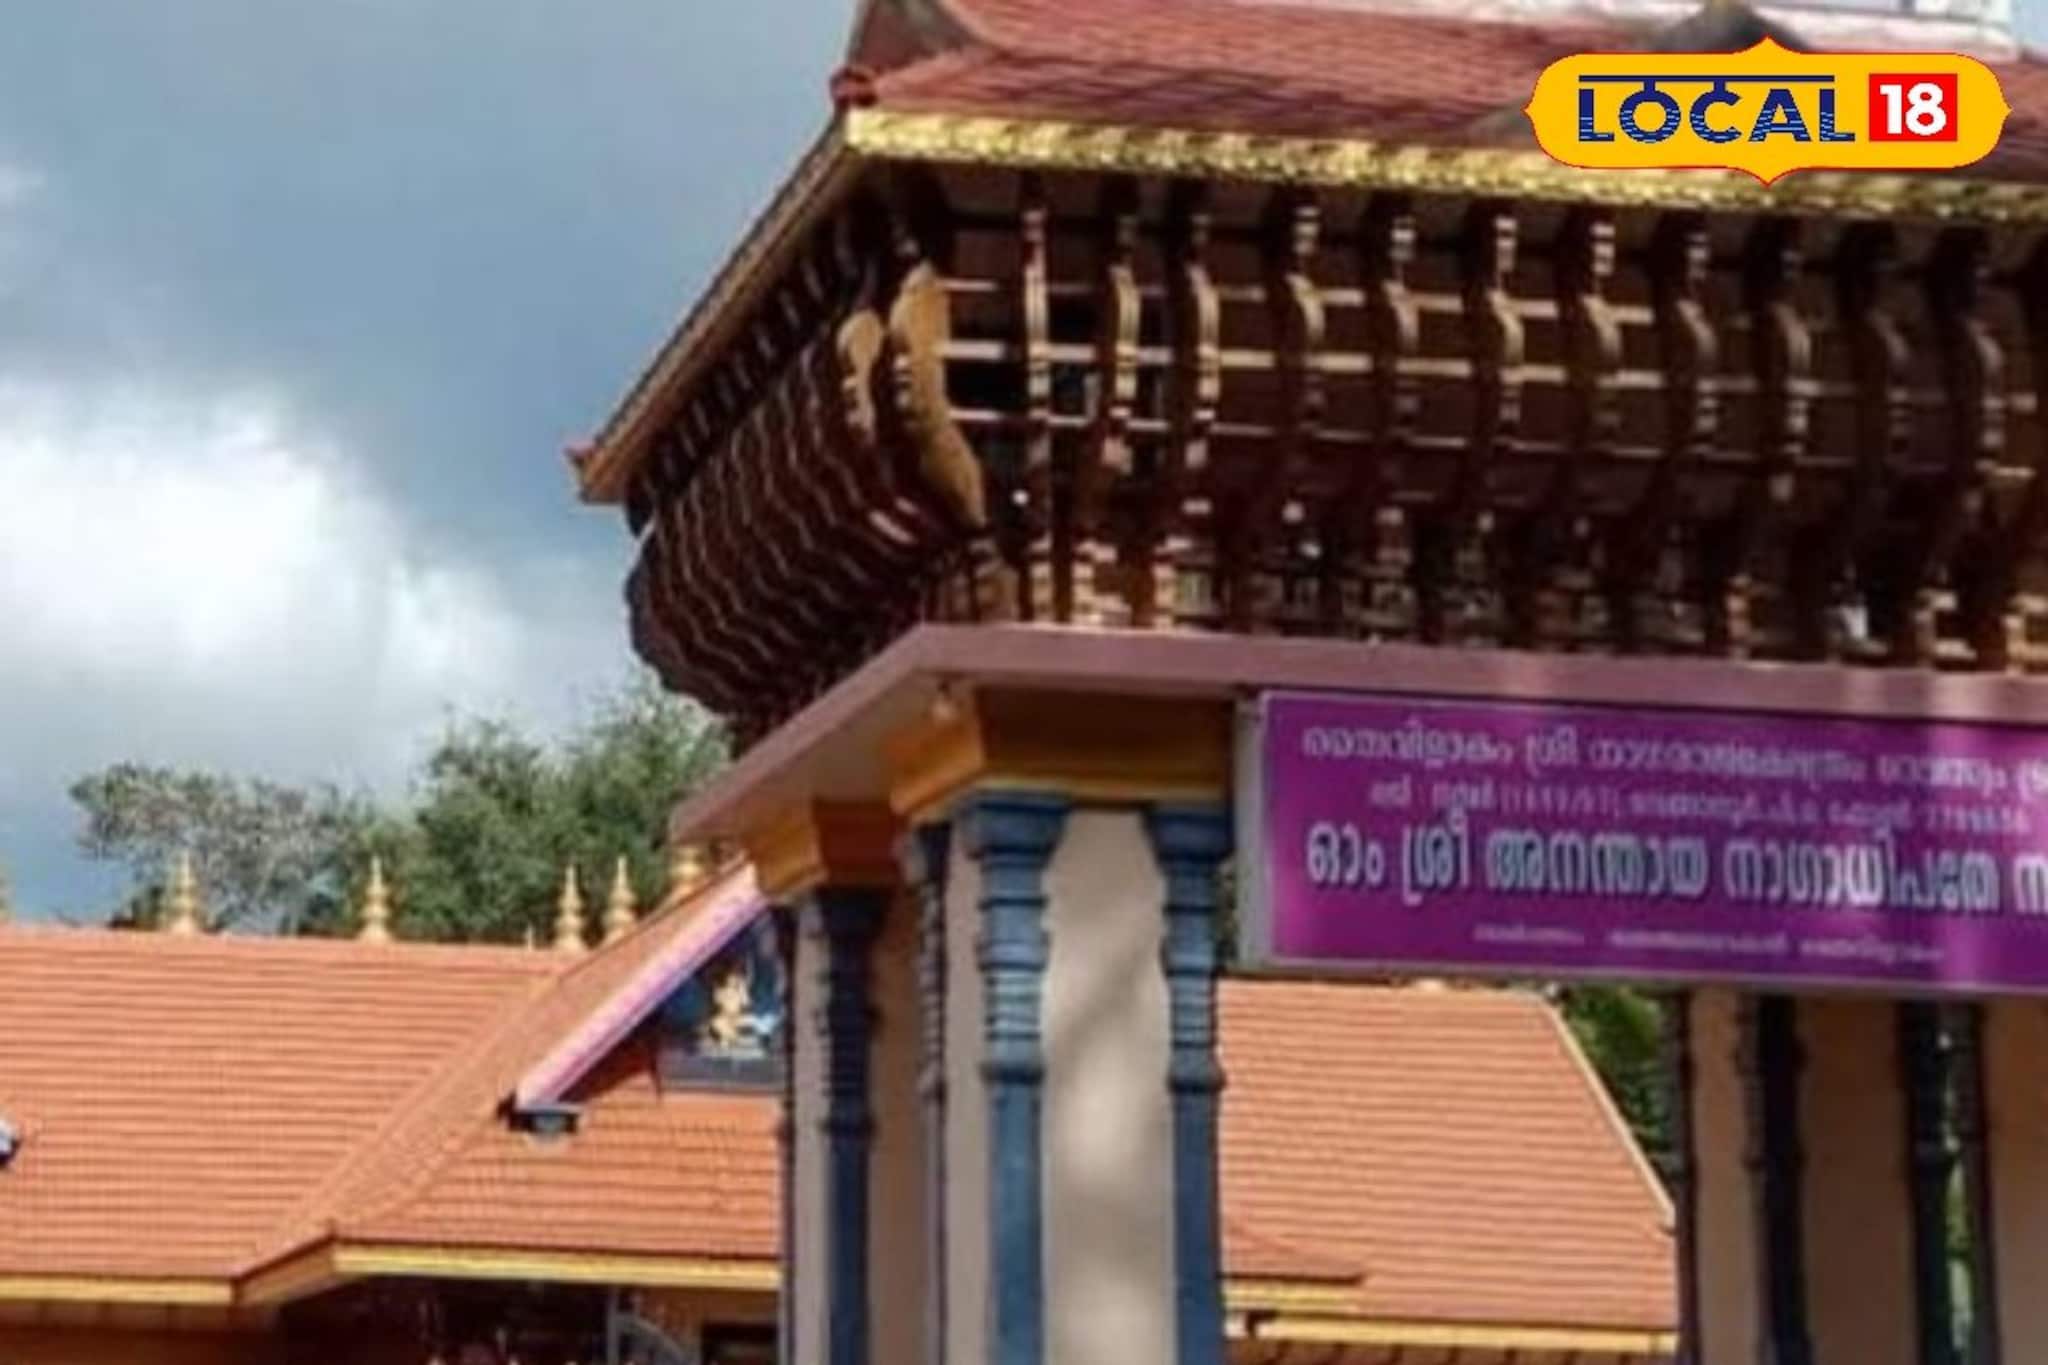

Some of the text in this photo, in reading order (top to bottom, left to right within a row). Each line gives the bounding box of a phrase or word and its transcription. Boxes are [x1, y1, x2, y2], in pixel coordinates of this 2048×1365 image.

[1306, 822, 1386, 887] ഓം
[1402, 805, 1470, 907] ശ്രീ
[1486, 828, 1709, 896] അനന്തായ
